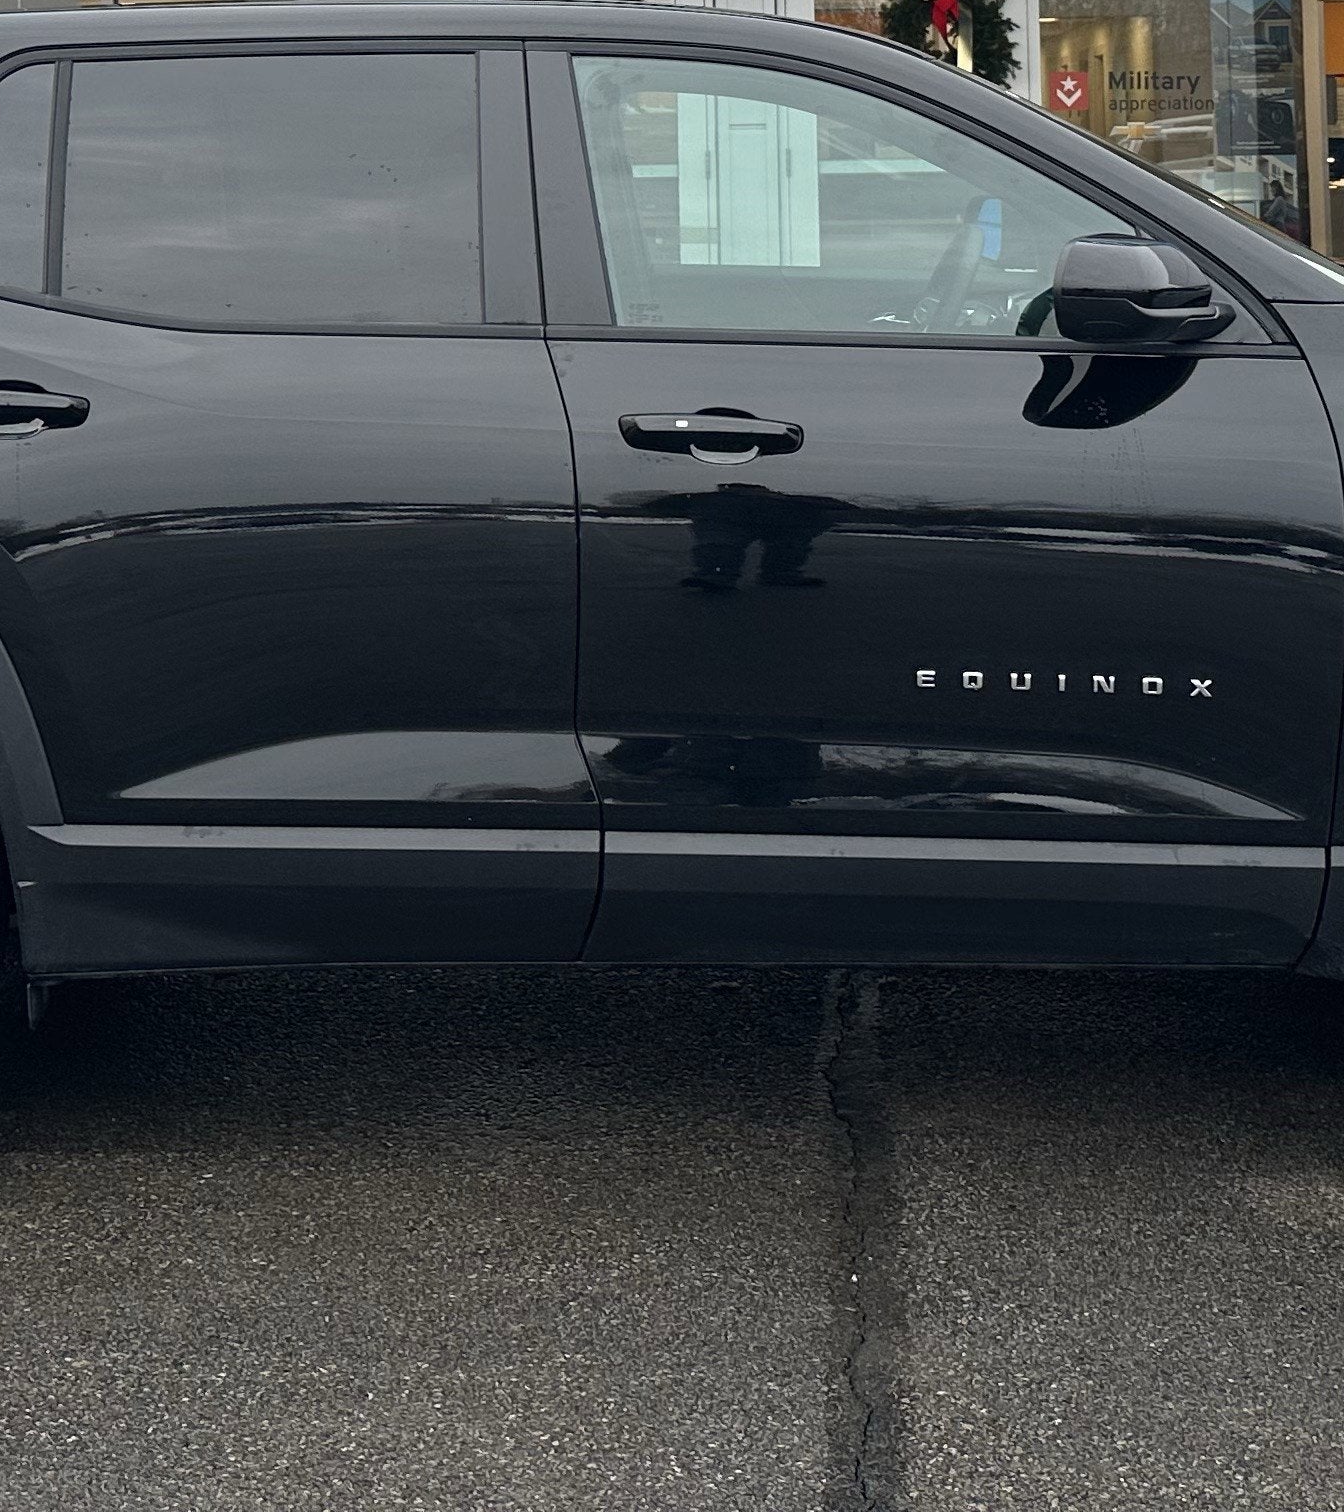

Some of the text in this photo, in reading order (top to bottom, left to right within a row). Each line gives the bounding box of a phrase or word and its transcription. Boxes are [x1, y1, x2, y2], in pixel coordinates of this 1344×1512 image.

[1108, 71, 1201, 94] Military
[1108, 99, 1214, 112] appreciation
[916, 670, 1213, 697] EQUINOX
